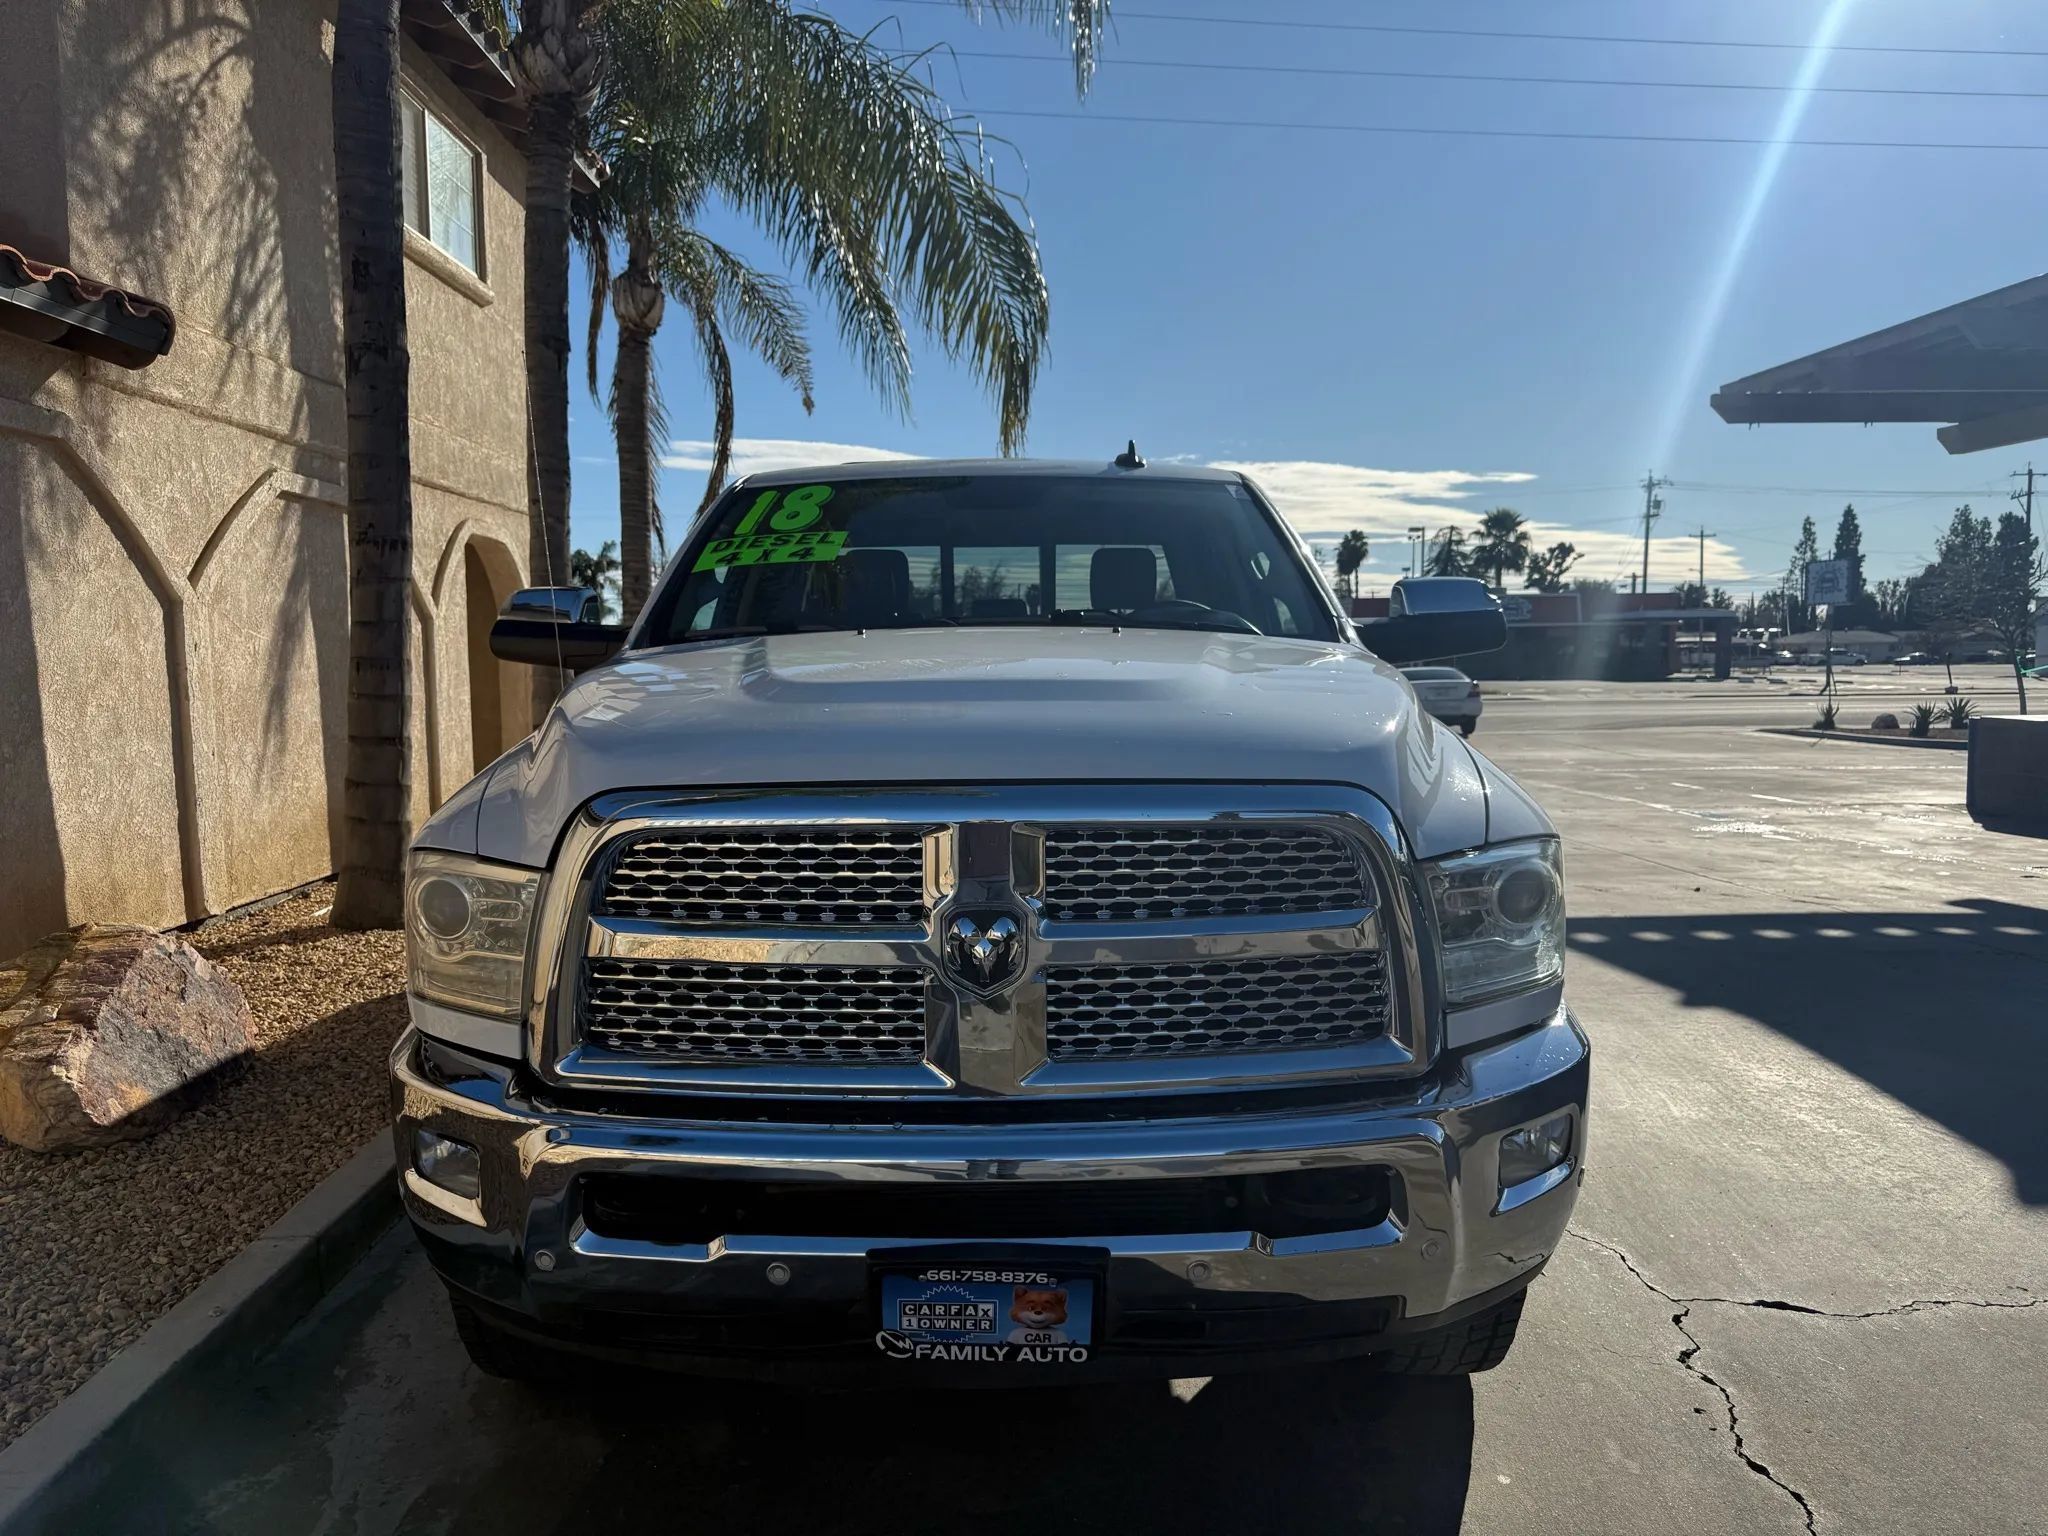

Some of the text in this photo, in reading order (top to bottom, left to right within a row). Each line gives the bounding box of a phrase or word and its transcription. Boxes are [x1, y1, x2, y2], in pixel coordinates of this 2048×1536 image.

[733, 485, 835, 535] 18
[710, 531, 836, 554] DIESEL
[926, 1270, 1048, 1284] 661-758-8376
[904, 1303, 992, 1318] CARFAX
[920, 1318, 992, 1330] OWNER
[1024, 1332, 1052, 1344] CAR
[915, 1344, 1088, 1363] FAMILY AUTO
